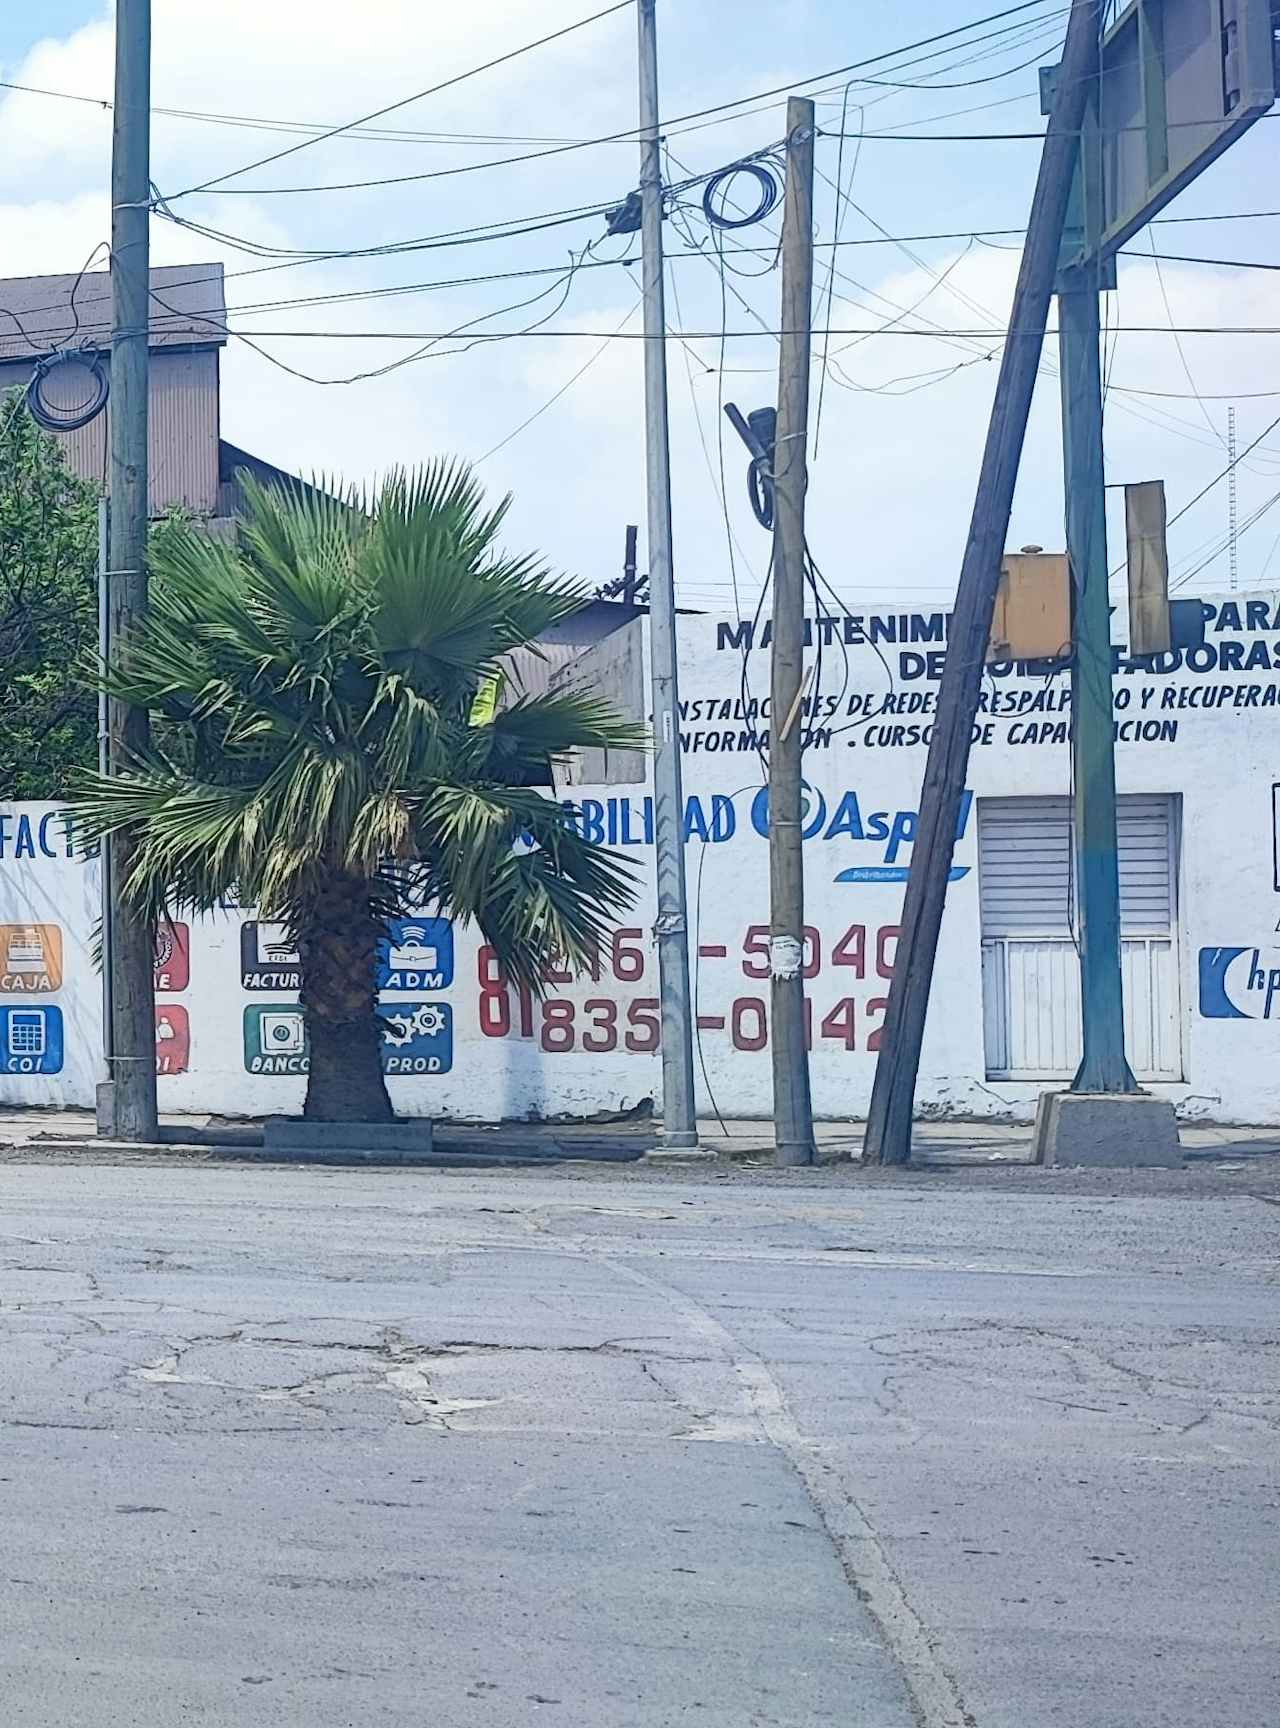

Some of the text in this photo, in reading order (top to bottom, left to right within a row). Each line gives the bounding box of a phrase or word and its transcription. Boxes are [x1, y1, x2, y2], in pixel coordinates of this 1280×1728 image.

[1201, 601, 1280, 632] PAR
[899, 651, 947, 680] DE
[676, 696, 838, 721] NSTALACNES
[847, 693, 875, 716] DE
[882, 692, 940, 714] REDE
[1141, 687, 1155, 709] Y
[1160, 684, 1280, 710] RECUPERA
[678, 720, 1178, 752] NFORMAON CURSO DE CAPACION
[822, 790, 974, 864] Aspl
[0, 975, 52, 991] CAJA
[243, 972, 305, 988] FACTUR
[385, 972, 444, 988] ADM
[1248, 949, 1280, 1019] hp
[540, 996, 892, 1052] 835-042
[7, 1057, 42, 1072] COI
[386, 1056, 441, 1073] PROD
